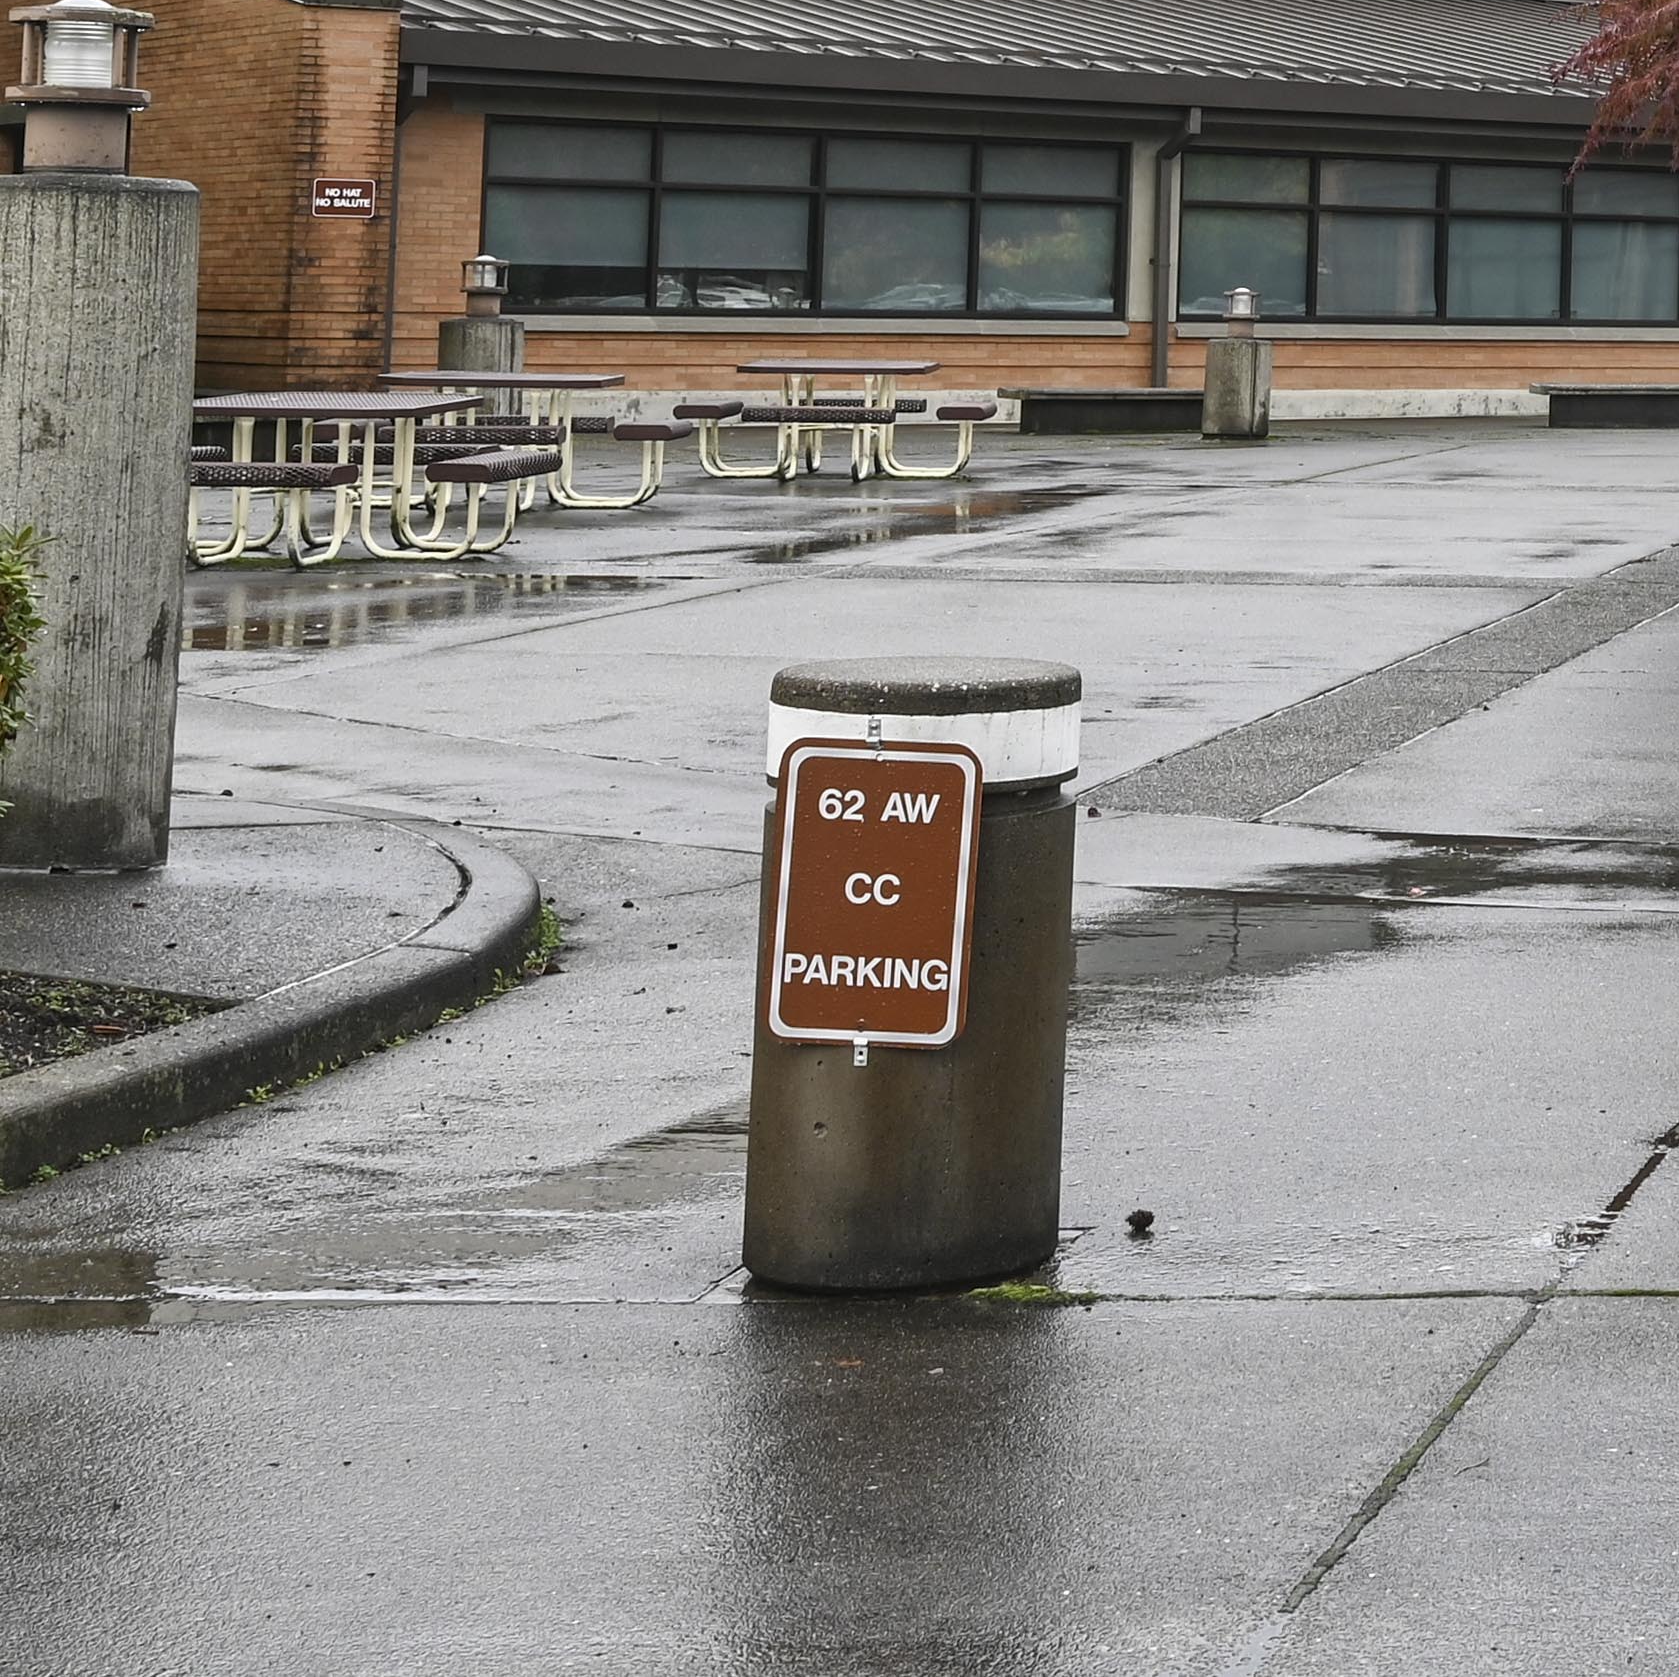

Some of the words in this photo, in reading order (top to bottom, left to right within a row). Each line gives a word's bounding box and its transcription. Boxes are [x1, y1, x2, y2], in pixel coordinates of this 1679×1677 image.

[316, 197, 331, 207] NO
[333, 198, 371, 208] SALUTE
[325, 188, 340, 197] NO
[342, 188, 362, 197] HAT
[818, 788, 866, 822] 62
[880, 792, 940, 824] AW
[844, 872, 901, 906] CC
[783, 953, 949, 991] PARKING
